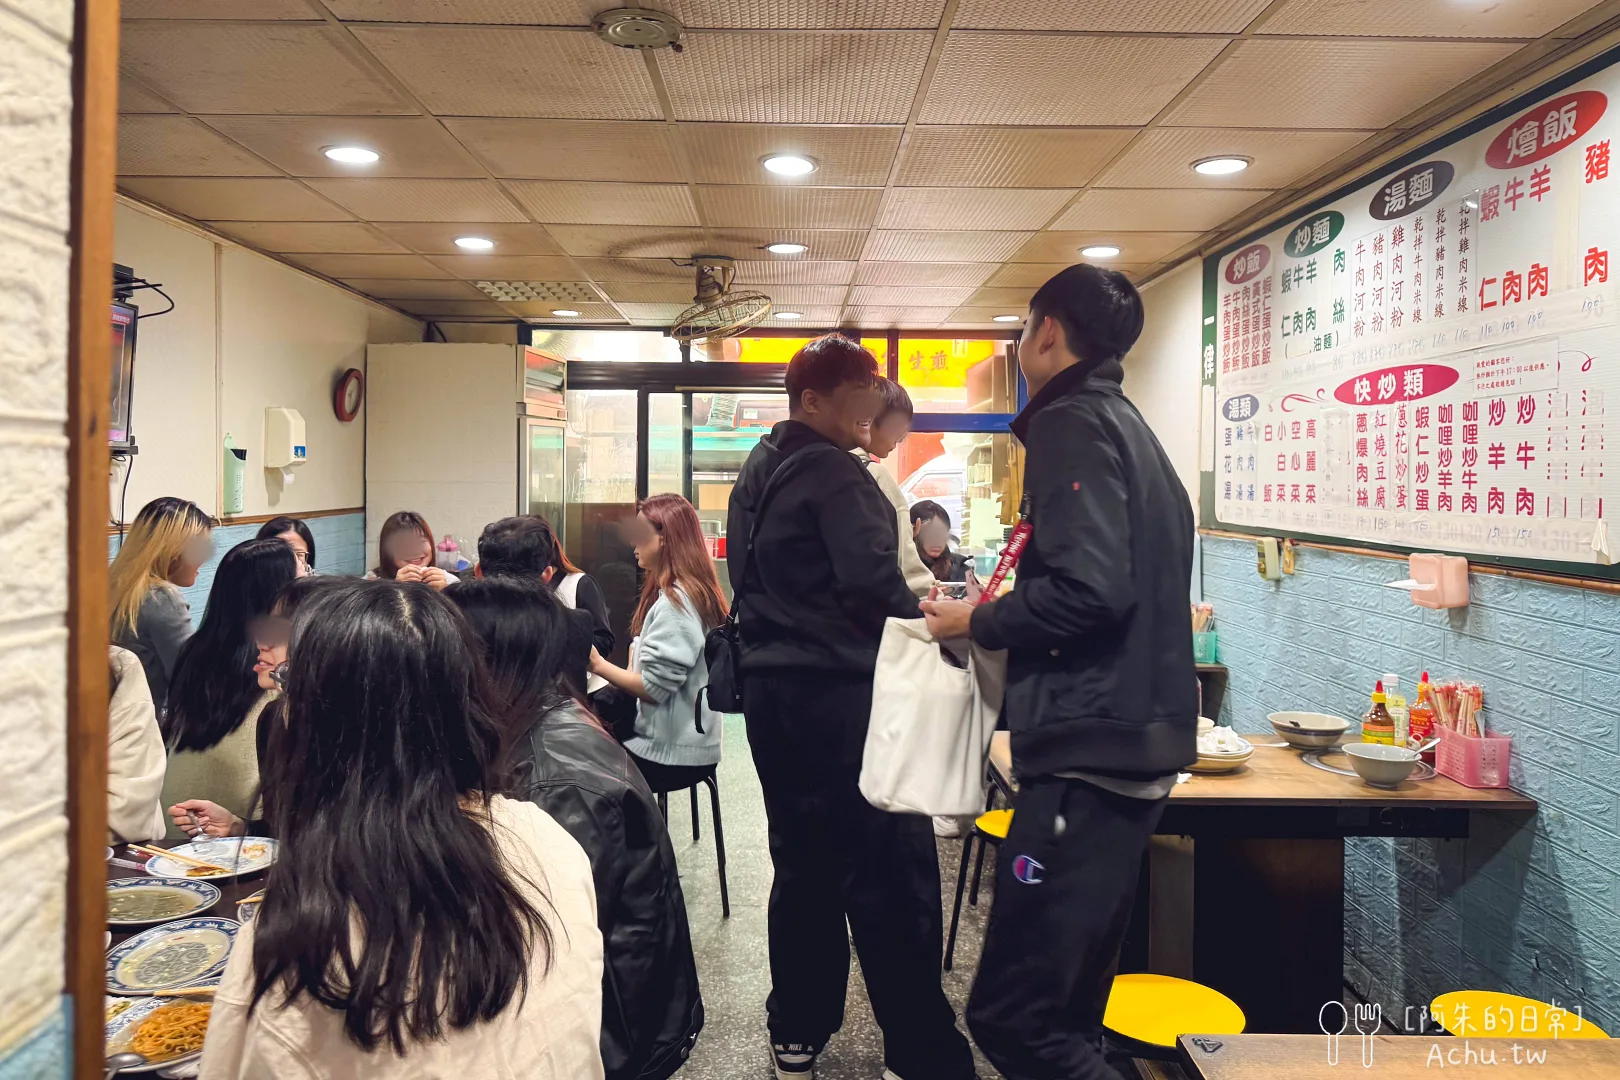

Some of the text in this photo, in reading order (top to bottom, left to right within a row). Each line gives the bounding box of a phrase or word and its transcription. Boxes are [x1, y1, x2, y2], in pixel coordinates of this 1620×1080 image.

[1506, 101, 1578, 164] 燴飯
[1294, 218, 1330, 254] 炒麵
[1384, 168, 1434, 216] 湯麵
[1233, 250, 1260, 280] 炒飯
[1354, 240, 1366, 338] 牛肉河粉
[1371, 233, 1385, 334] 豬肉河粉
[1391, 225, 1405, 328] 雞肉河粉
[1413, 216, 1424, 323] 乾拌牛肉米線
[1435, 208, 1447, 318] 乾拌豬肉米線
[1354, 368, 1424, 403] 快炒類
[1291, 420, 1301, 503] 空心菜
[1306, 419, 1316, 504] 高麗菜
[1356, 413, 1368, 508] 蔥爆肉絲
[1374, 409, 1387, 509] 紅燒豆腐
[1415, 406, 1429, 511] 蝦仁炒蛋
[1437, 404, 1453, 512] 咖哩炒羊肉
[1462, 401, 1478, 513] 咖哩炒牛肉
[1488, 398, 1506, 514] 炒羊肉
[1516, 394, 1536, 516] 炒牛肉
[788, 1043, 803, 1051] NIKE
